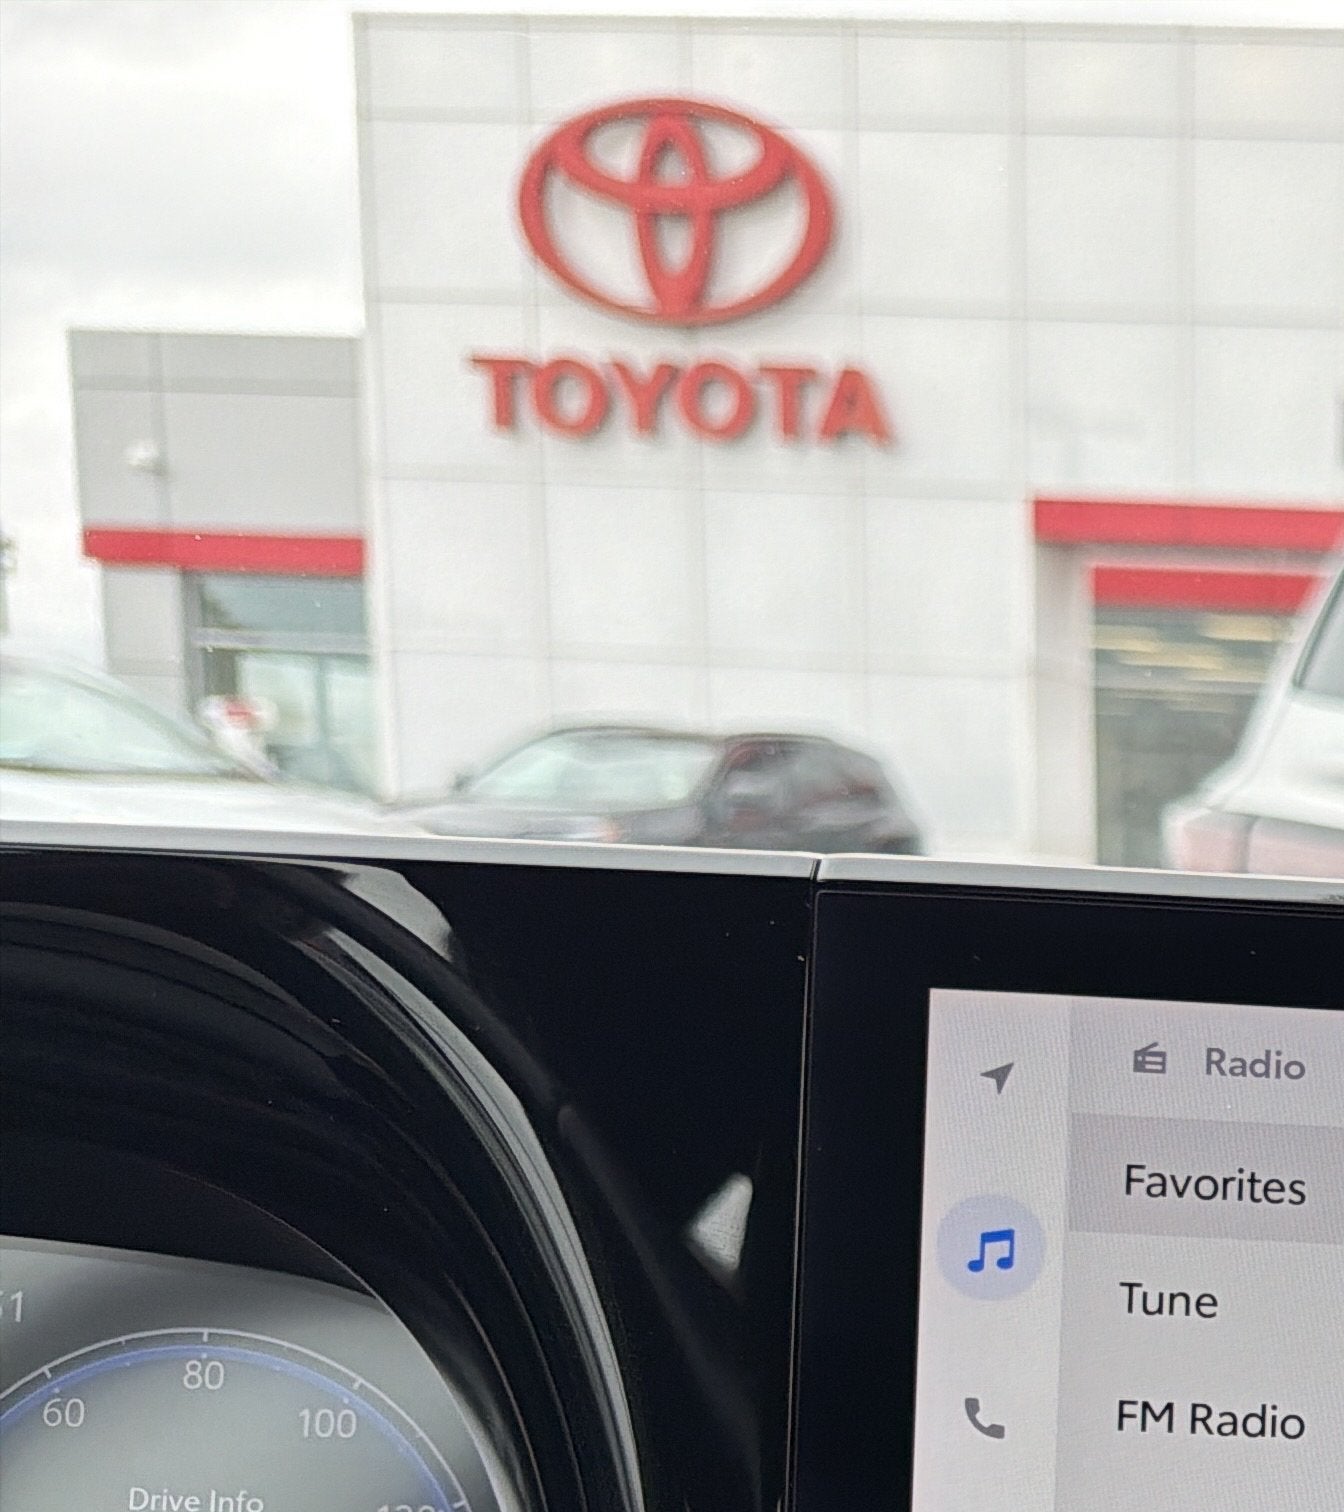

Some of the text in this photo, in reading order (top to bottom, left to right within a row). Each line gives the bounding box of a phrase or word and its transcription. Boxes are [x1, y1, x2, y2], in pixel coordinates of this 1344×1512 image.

[470, 356, 892, 446] TOYOTA
[1205, 1047, 1306, 1080] Radio
[1125, 1164, 1306, 1206] Favorites
[0, 1289, 24, 1324] 1
[1119, 1281, 1218, 1319] Tune
[182, 1361, 224, 1390] 80
[42, 1399, 85, 1428] 60
[299, 1408, 357, 1438] 100
[1117, 1399, 1305, 1440] FM Radio
[128, 1487, 201, 1512] Drive
